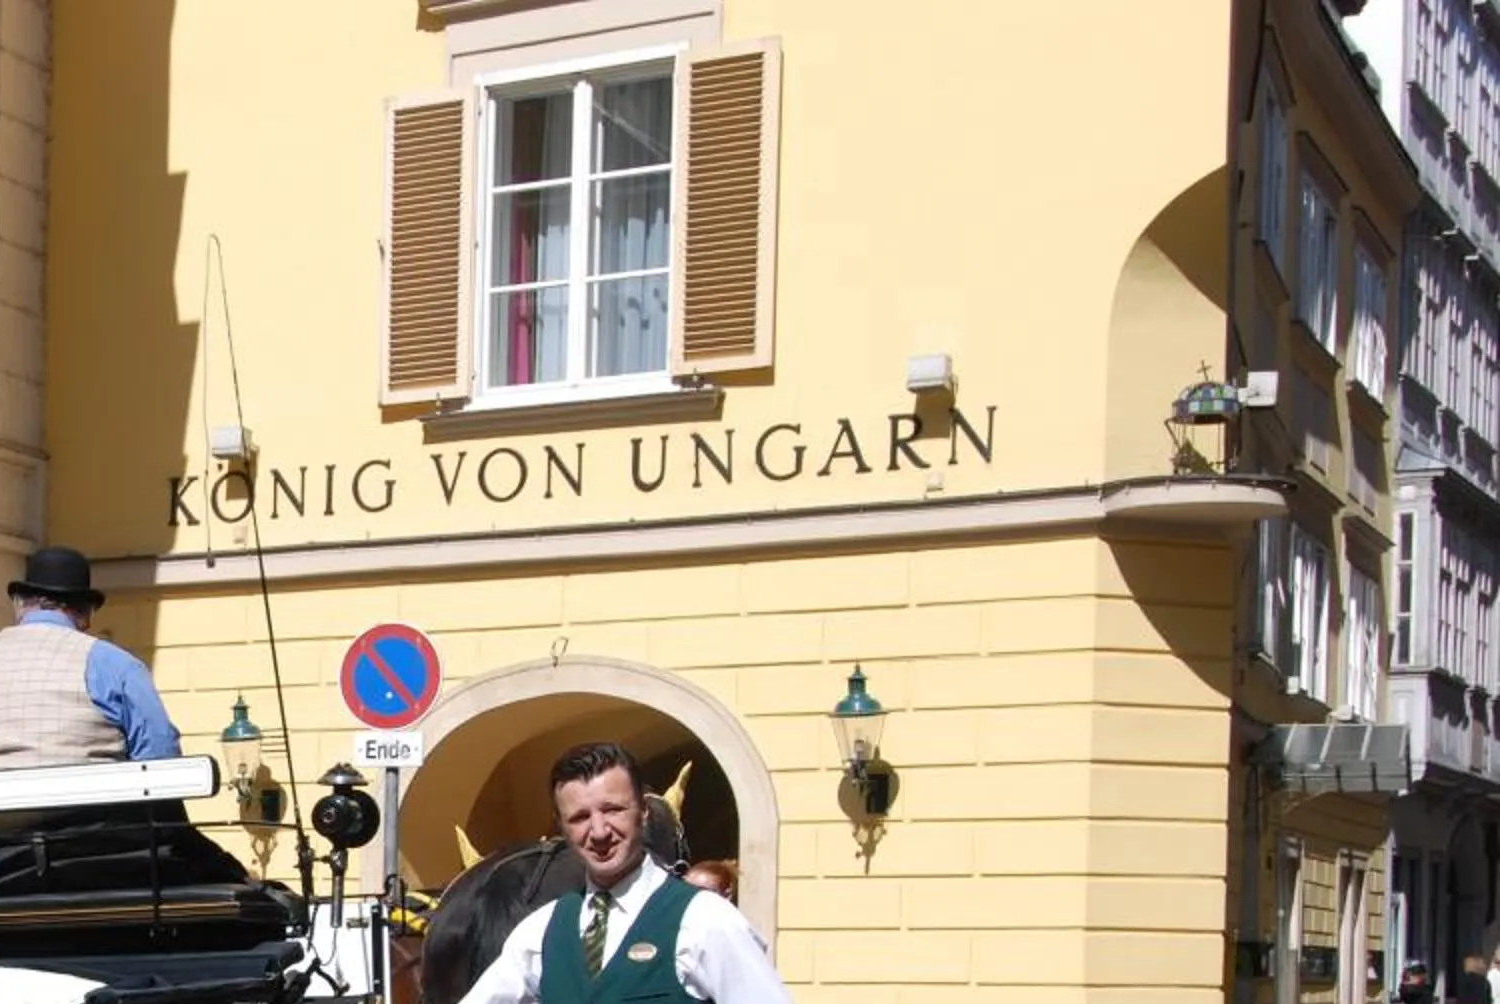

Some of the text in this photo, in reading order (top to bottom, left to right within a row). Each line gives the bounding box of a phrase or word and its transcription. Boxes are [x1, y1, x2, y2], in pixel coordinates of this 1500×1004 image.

[167, 405, 997, 527] KÖNIG VON UNGARN
[365, 738, 411, 760] Ende
